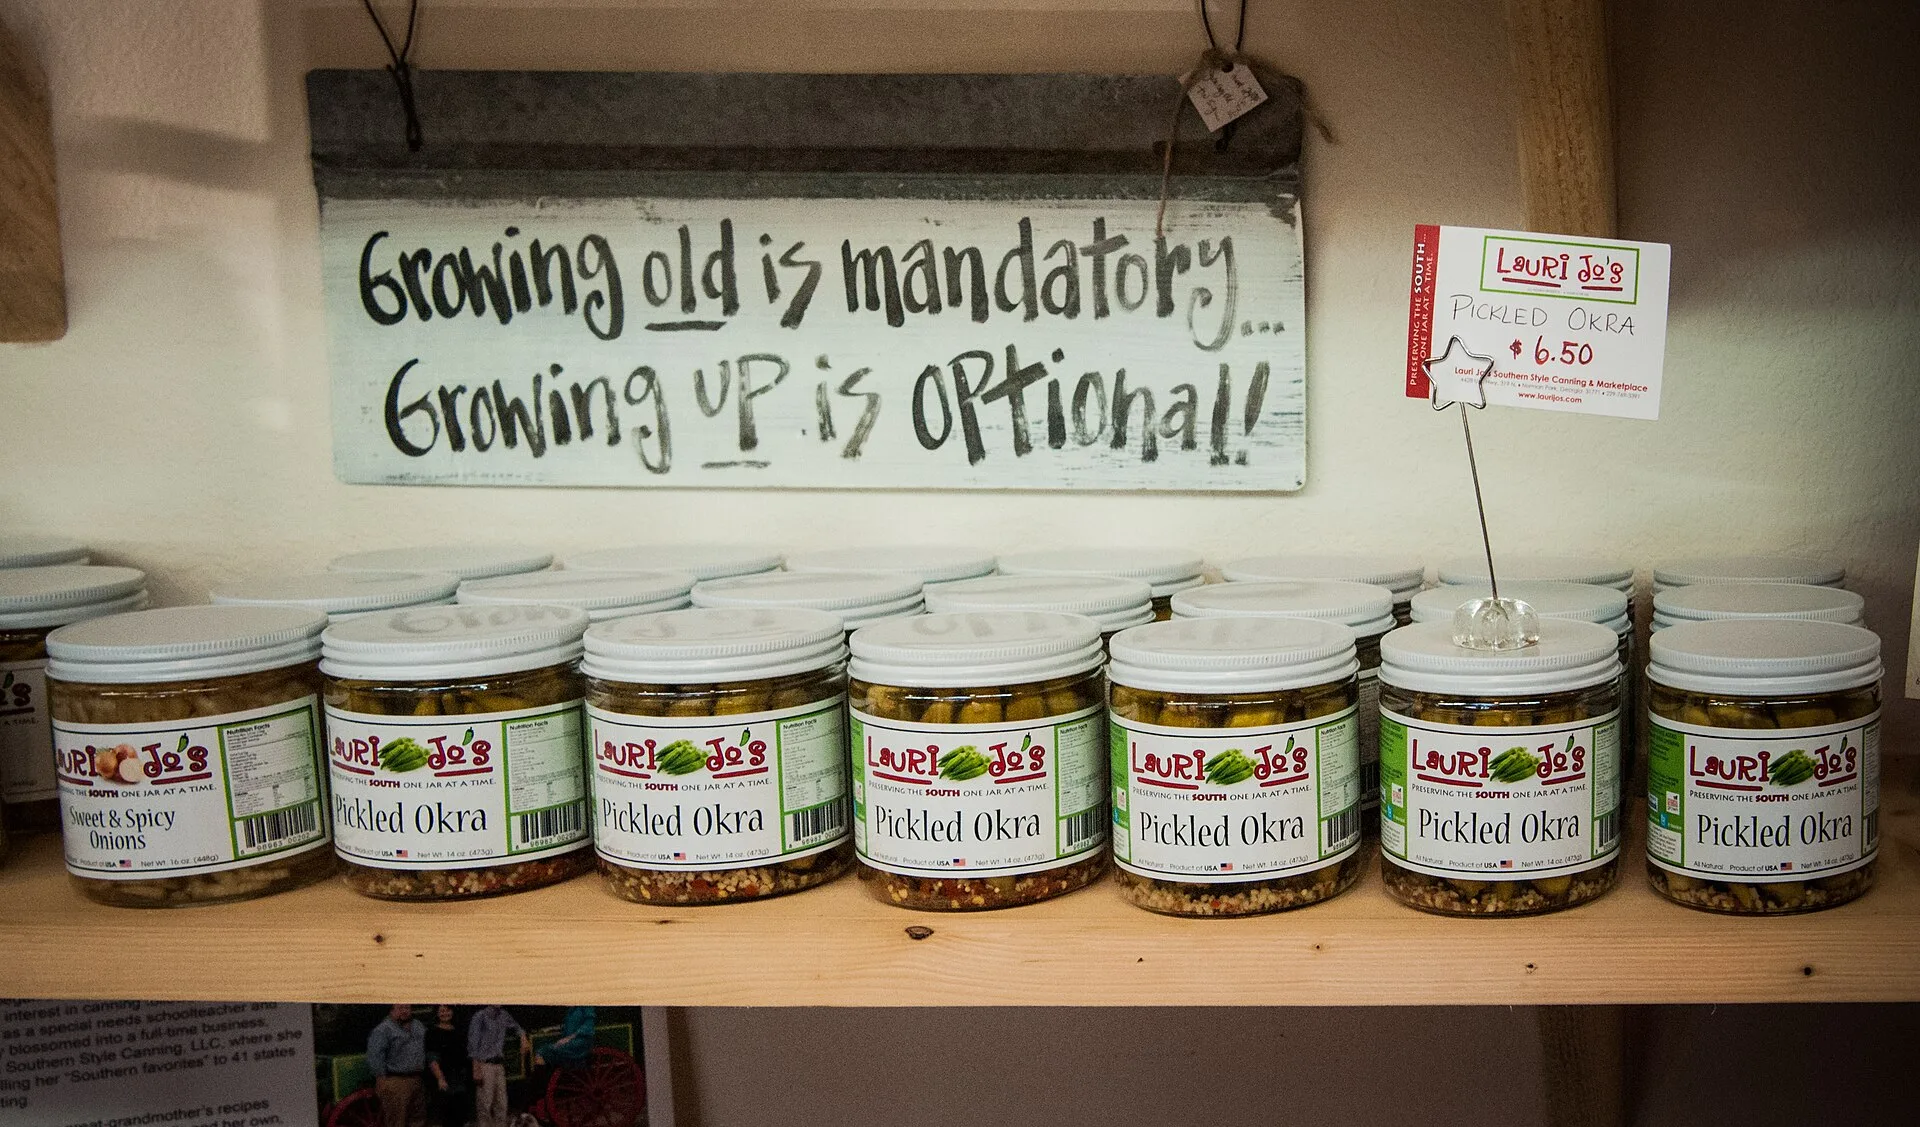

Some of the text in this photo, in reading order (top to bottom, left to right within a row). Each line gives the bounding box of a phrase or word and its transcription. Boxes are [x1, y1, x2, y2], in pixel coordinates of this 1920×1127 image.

[360, 226, 623, 340] Growing
[644, 218, 739, 318] old
[760, 234, 821, 329] is
[1425, 253, 1433, 284] TIME.
[1578, 255, 1624, 284] Jo's
[1424, 286, 1430, 295] A
[1424, 298, 1429, 312] AT
[1450, 294, 1635, 336] PICKLED OKRA
[1410, 321, 1420, 385] PRESERVING
[1510, 335, 1593, 365] $ 6.50
[1455, 367, 1473, 376] Lauri
[1494, 370, 1528, 380] Southern
[1530, 374, 1549, 383] Style
[1552, 375, 1587, 387] Canning
[1596, 380, 1648, 392] Marketplace
[1518, 391, 1582, 404] www.laurijos.com
[385, 358, 672, 474] Growing
[815, 353, 882, 459] is
[142, 733, 208, 777] Jo's
[427, 727, 492, 770] Jo's
[706, 727, 767, 772] Jo's
[989, 732, 1046, 777] Jo's
[1254, 734, 1308, 780] Jo's
[1536, 733, 1585, 778] Jo's
[1814, 734, 1856, 780] Jo's
[89, 790, 118, 798] SOUTH
[144, 789, 160, 797] JAR
[369, 779, 400, 788] SOUTH
[472, 778, 496, 786] TIME.
[645, 782, 678, 791] SOUTH
[704, 783, 720, 791] JAR
[748, 778, 772, 786] TIME.
[868, 780, 905, 794] PRESERVING
[925, 789, 960, 797] SOUTH
[1028, 783, 1049, 791] TIME.
[1133, 787, 1171, 800] PRESERVING
[1192, 793, 1227, 801] SOUTH
[1269, 790, 1280, 798] AT
[1291, 785, 1311, 794] TIME.
[1412, 784, 1454, 797] PRESERVING
[1570, 784, 1587, 792] TIME.
[1690, 790, 1734, 802] PRESERVING
[1811, 791, 1825, 799] JAR
[70, 805, 175, 833] Sweet & Spicy
[335, 793, 488, 834] Pickled Okra
[602, 798, 764, 836] Pickled Okra
[875, 805, 963, 842] Pickled
[974, 809, 1040, 842] Okra
[1419, 808, 1510, 844] Pickled
[1522, 810, 1579, 844] Okra
[90, 830, 146, 850] Onions
[1140, 811, 1229, 847] Pickled
[1241, 812, 1304, 846] Okra
[1697, 813, 1791, 848] Pickled
[1800, 811, 1852, 845] Okra
[903, 857, 926, 865] Product
[1170, 863, 1194, 871] Product
[1449, 860, 1474, 869] Product
[1565, 854, 1582, 864] (473g)
[1701, 862, 1724, 870] Natural
[1729, 864, 1755, 872] Product
[4, 1004, 246, 1039] as a special needs schoolteacher
[5, 1006, 60, 1021] interest
[65, 1005, 78, 1015] in
[5, 1029, 302, 1073] Southern Style where she
[9, 1036, 91, 1056] blossomed
[96, 1033, 123, 1046] into
[127, 1033, 136, 1042] a
[35, 1075, 59, 1087] her
[213, 1055, 227, 1066] to
[232, 1052, 247, 1061] 41
[254, 1047, 296, 1060] states
[218, 1100, 269, 1114] recipes
